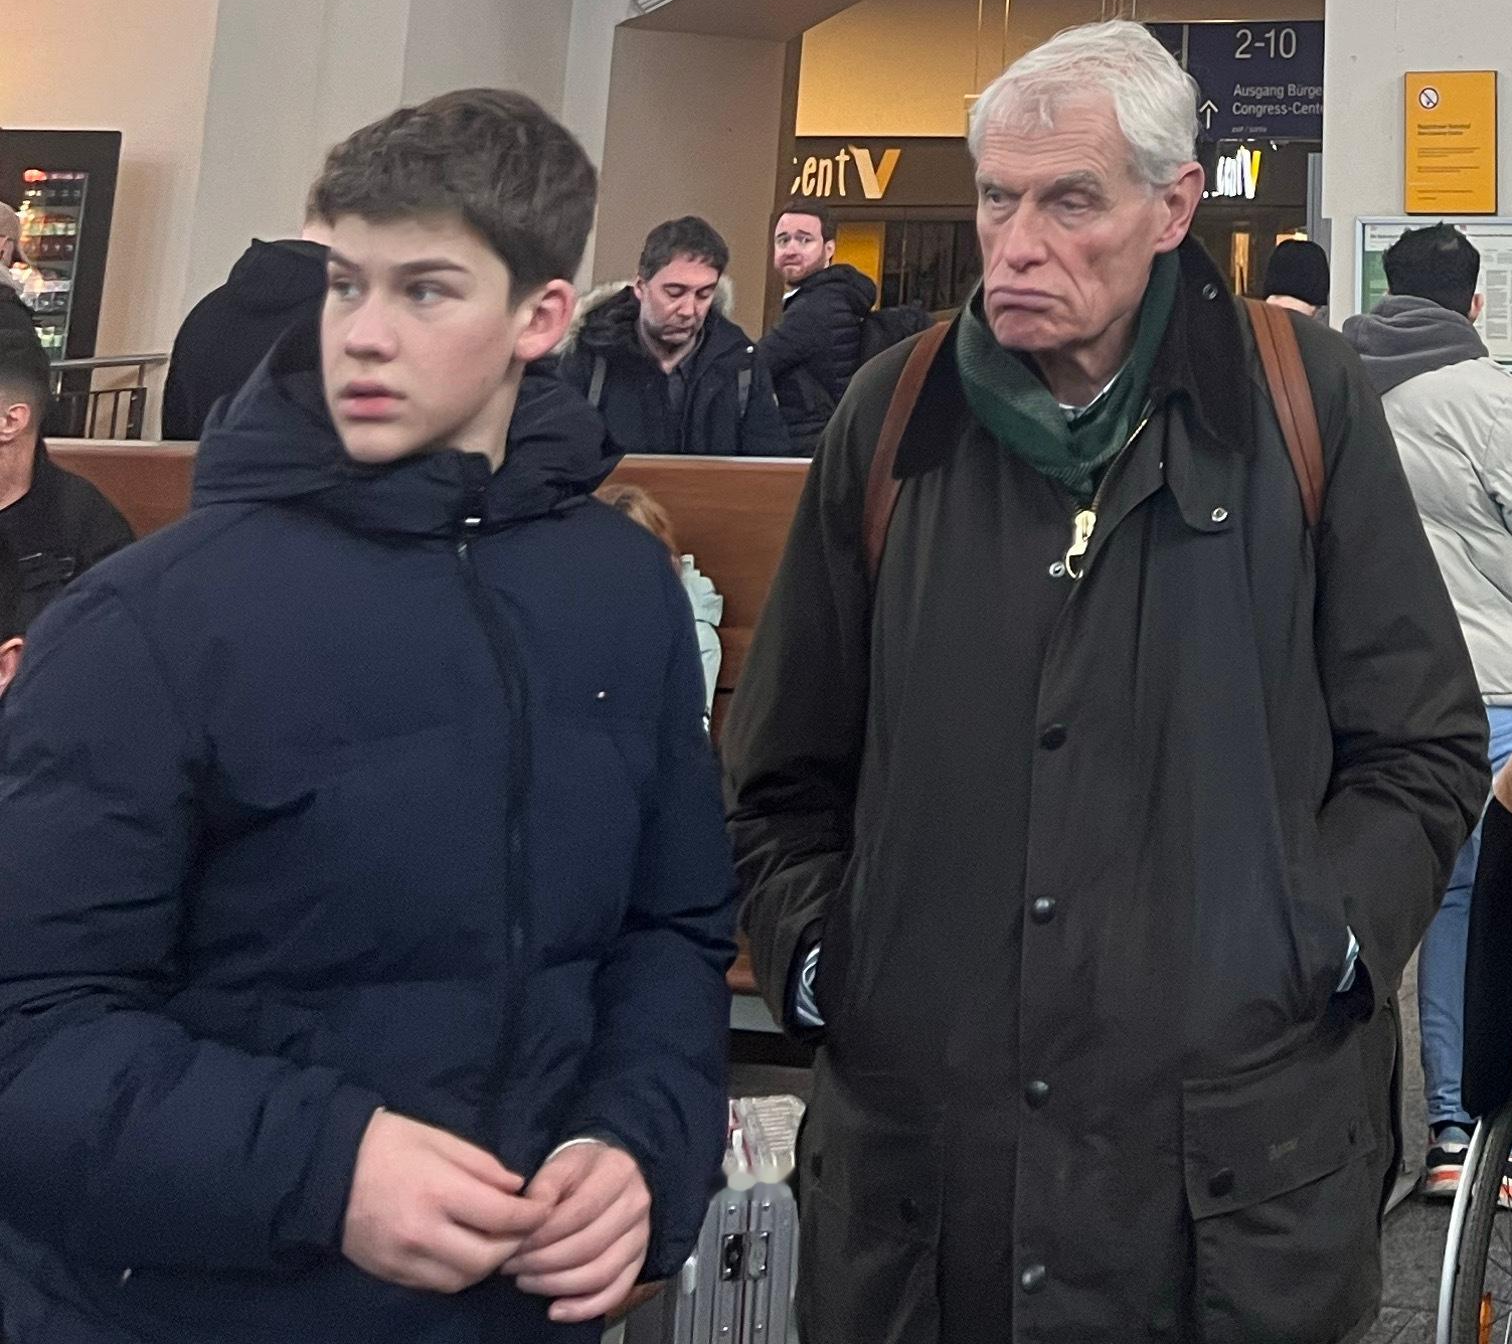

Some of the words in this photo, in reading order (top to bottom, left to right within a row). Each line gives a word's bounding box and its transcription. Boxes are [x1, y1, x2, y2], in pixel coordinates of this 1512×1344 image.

[1235, 28, 1297, 59] 2-10
[1233, 84, 1284, 99] Ausgang
[1287, 83, 1323, 99] Bürge
[1232, 102, 1323, 117] Congress-Cent
